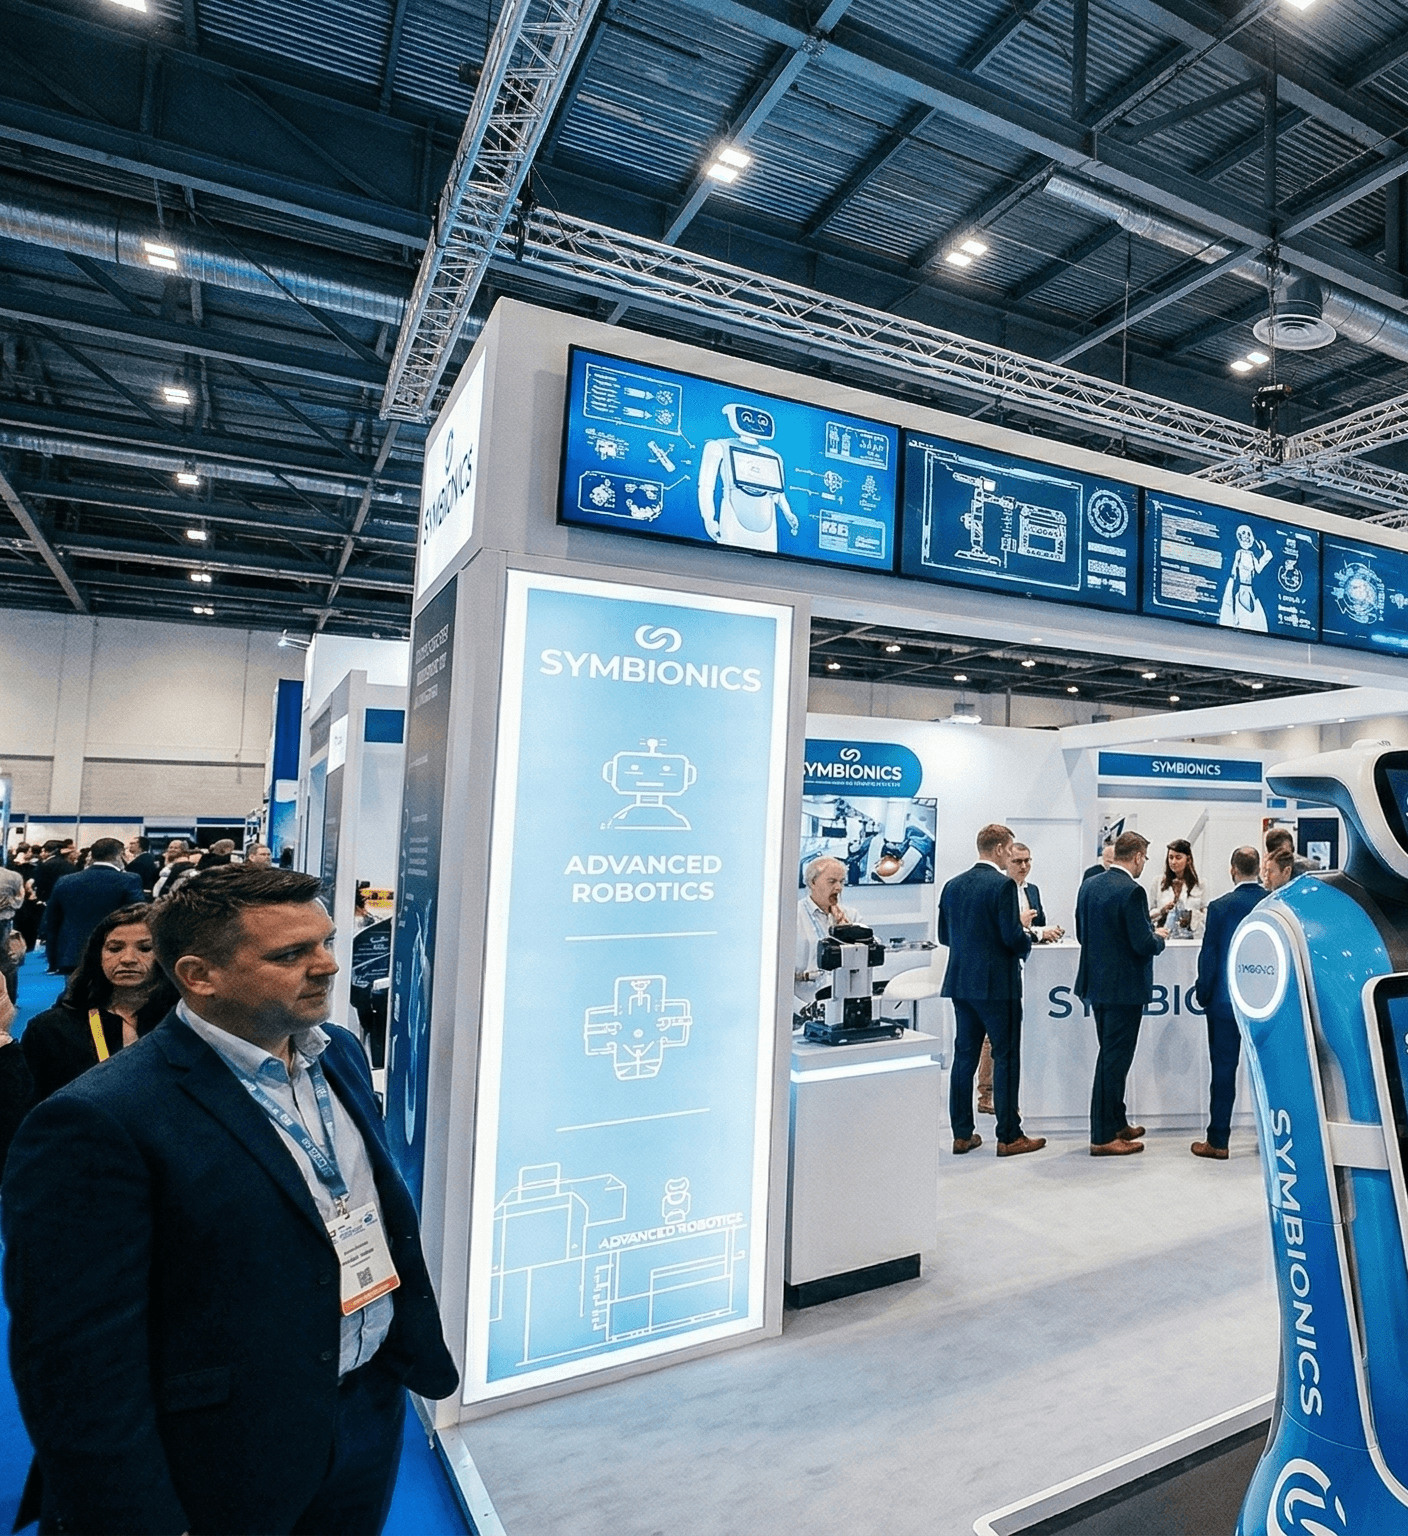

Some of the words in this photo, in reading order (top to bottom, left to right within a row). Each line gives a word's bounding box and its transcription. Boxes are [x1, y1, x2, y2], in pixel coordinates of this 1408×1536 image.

[539, 648, 763, 693] SYMBIONICS
[1151, 760, 1222, 776] SYMBIONICS
[563, 854, 723, 876] ADVANCED
[571, 881, 715, 904] ROBOTICS
[1269, 1108, 1323, 1417] SYMBIONICS
